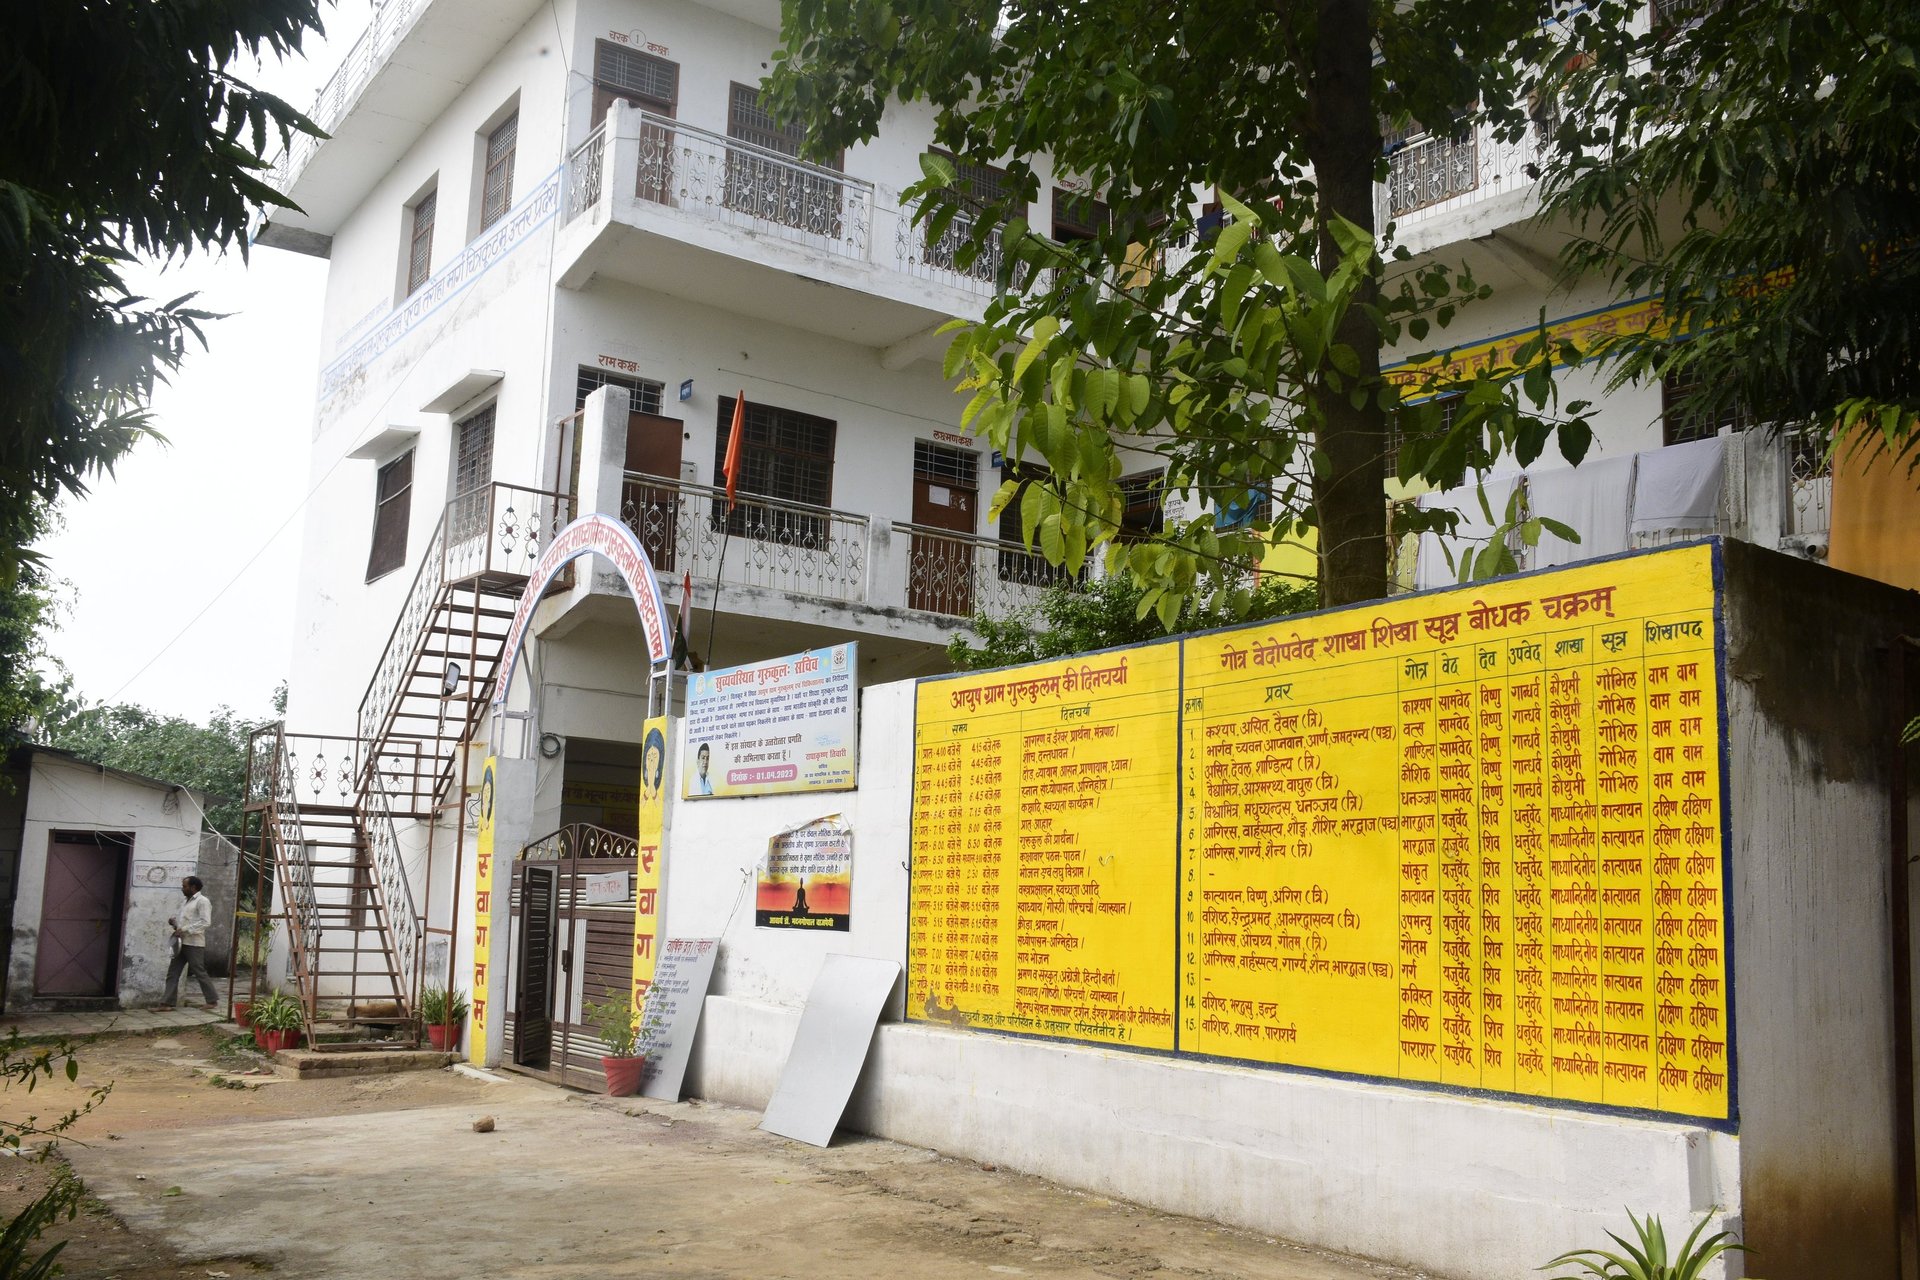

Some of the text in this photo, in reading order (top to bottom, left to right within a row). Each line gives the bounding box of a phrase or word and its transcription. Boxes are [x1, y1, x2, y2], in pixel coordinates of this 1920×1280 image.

[608, 30, 630, 44] चरक
[598, 354, 617, 368] राम
[1220, 643, 1249, 671] गोत्र
[1251, 632, 1319, 668] वेदोपवेद
[1369, 616, 1419, 649] शिखा
[1422, 612, 1462, 645] सूत्र
[1466, 599, 1532, 631] बोधक
[1539, 585, 1617, 621] चक्रम्
[794, 656, 819, 674] सचिव
[1264, 682, 1294, 704] प्रवर
[1404, 657, 1429, 680] गोत्र
[1441, 652, 1460, 676] वेद
[1478, 647, 1498, 672] देव
[1507, 637, 1542, 666] उपवेद
[1600, 630, 1629, 654] सूत्र
[1644, 620, 1704, 645] शिखापद
[950, 687, 983, 713] आयुष
[983, 683, 1006, 705] ग्राम
[1061, 666, 1080, 693] की
[1079, 655, 1128, 694] दिनचर्या
[1401, 697, 1434, 716] काश्यप
[1437, 688, 1472, 712] सामवेद
[1479, 683, 1503, 709] विष्णु
[1595, 666, 1638, 692] गोभिल
[1648, 665, 1670, 685] वाम
[1676, 662, 1700, 682] वाम
[1060, 702, 1092, 721] दिनचर्या
[1402, 721, 1426, 738] वत्स
[731, 741, 738, 750] इस
[758, 738, 763, 747] के
[788, 733, 802, 743] प्रगति
[734, 754, 741, 763] की
[767, 752, 780, 761] करता
[756, 769, 793, 780] 01.04.2023
[1400, 761, 1431, 785] कौशिक
[1480, 803, 1500, 828] शिव
[1600, 801, 1644, 823] कात्यायन
[1400, 889, 1436, 908] कात्यायन
[1400, 933, 1428, 958] गौतम
[1401, 958, 1418, 980] गर्ग
[1401, 1040, 1437, 1061] पाराशर
[1483, 1042, 1503, 1068] शिव
